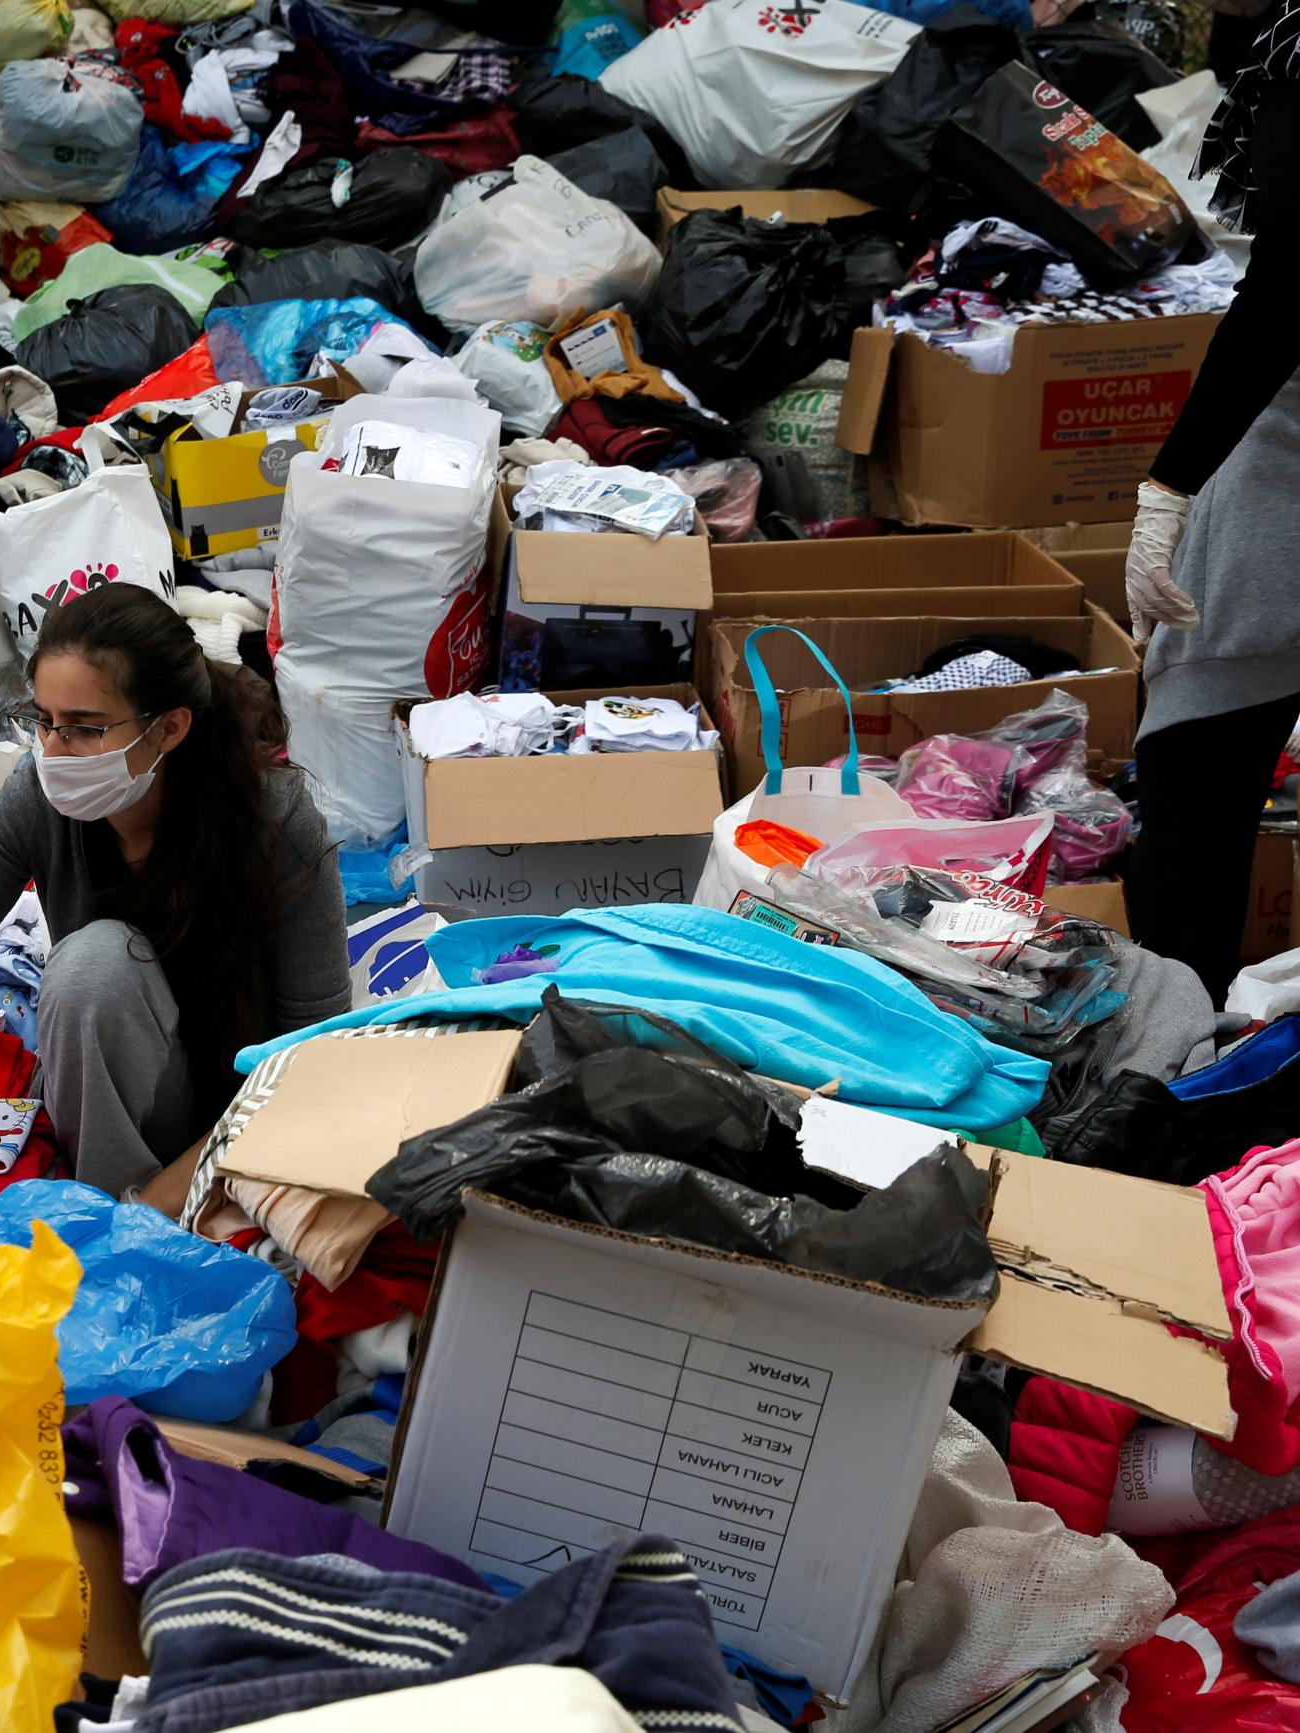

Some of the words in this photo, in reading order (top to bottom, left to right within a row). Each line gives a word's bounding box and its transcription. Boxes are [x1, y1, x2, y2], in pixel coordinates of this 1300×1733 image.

[1084, 378, 1152, 403] UÇAR
[1056, 401, 1175, 425] OYUNCAK
[765, 421, 818, 445] sev.
[263, 526, 281, 537] Erk
[554, 866, 686, 904] BAYAN
[747, 1361, 811, 1389] YAPRAK
[756, 1400, 803, 1422] ACUR
[741, 1431, 793, 1456] KELEK
[677, 1449, 741, 1477] LAHANA
[1119, 1446, 1137, 1501] SCOTCH
[1132, 1433, 1149, 1501] BROTHERS
[742, 1468, 785, 1488] ACILI
[711, 1493, 775, 1520] LAHANA
[718, 1529, 767, 1552] BİBER
[683, 1553, 758, 1583] SALATALI
[710, 1593, 748, 1614] TÜRL
